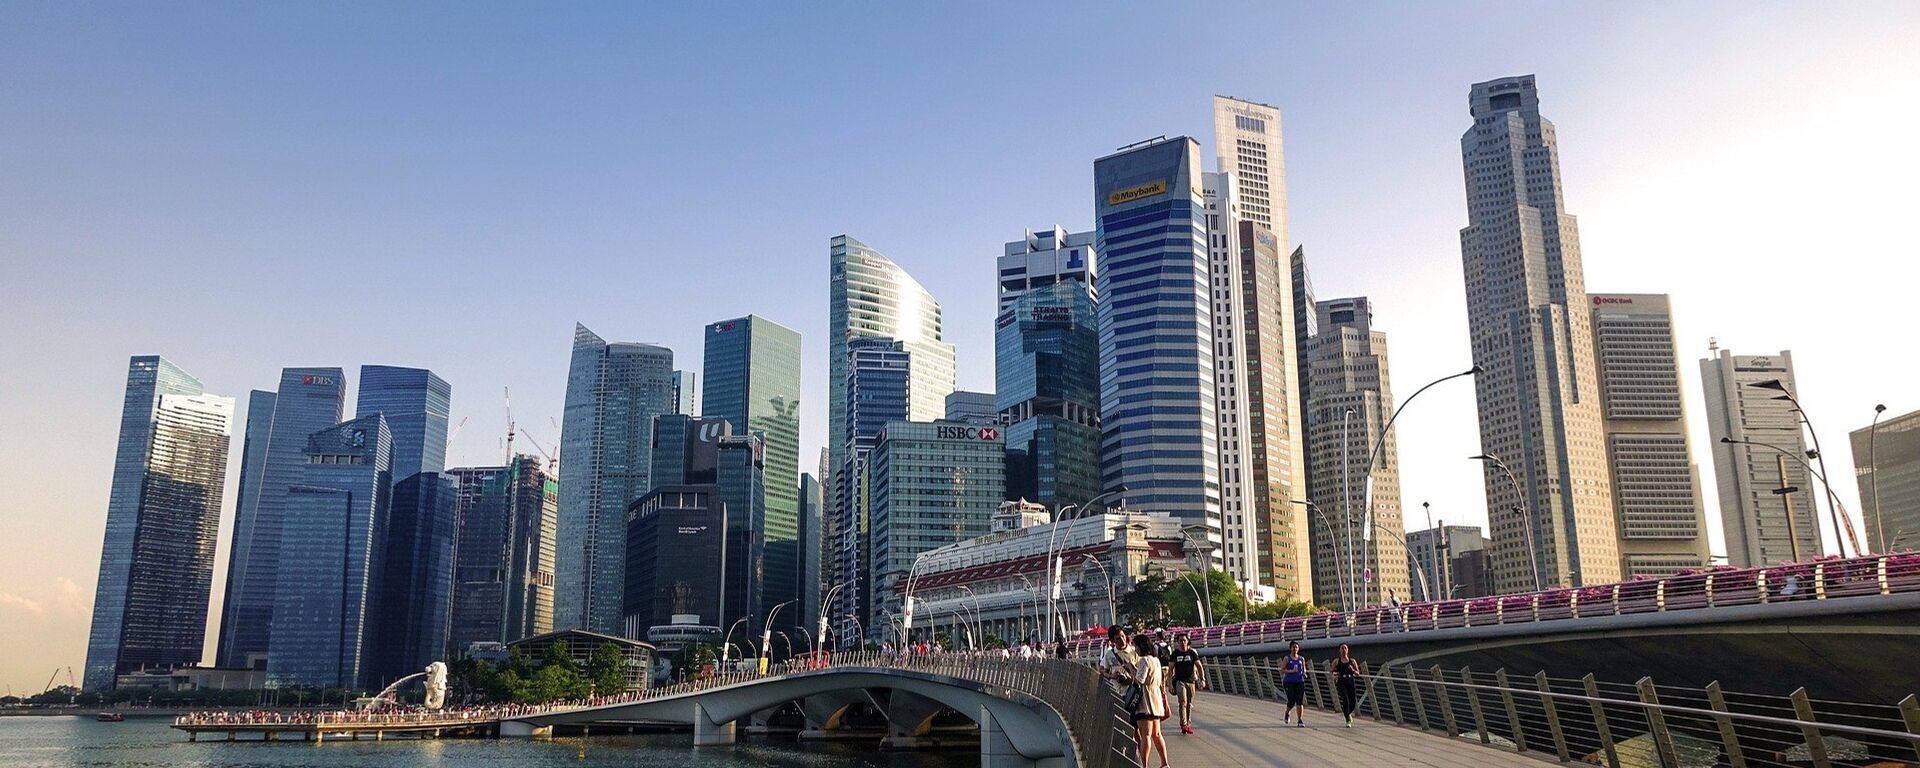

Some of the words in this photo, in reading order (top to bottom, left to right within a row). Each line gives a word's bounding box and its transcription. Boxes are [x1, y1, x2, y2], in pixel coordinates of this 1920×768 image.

[1120, 184, 1160, 200] Maybank
[312, 375, 334, 385] DBS
[936, 425, 976, 440] HSBC
